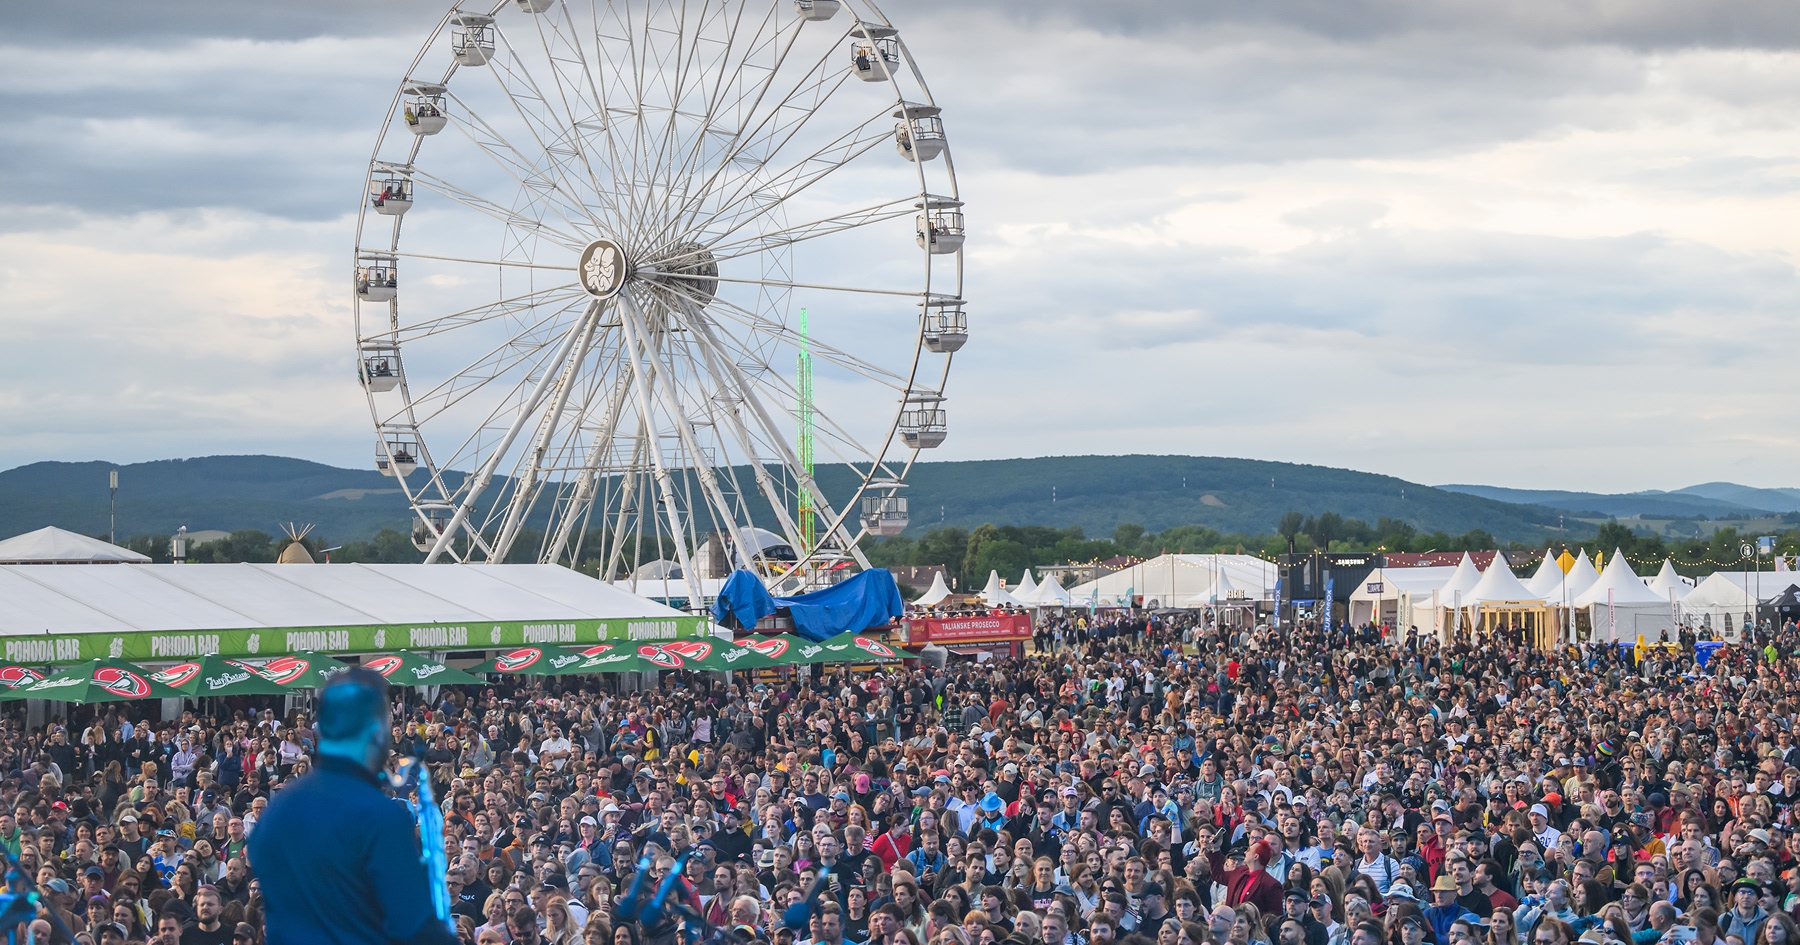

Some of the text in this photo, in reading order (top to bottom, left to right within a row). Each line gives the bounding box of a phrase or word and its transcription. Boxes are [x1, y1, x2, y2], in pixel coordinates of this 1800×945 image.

[523, 624, 577, 644] POHODA BAR
[627, 621, 677, 640] POHODA BAR
[942, 620, 1000, 631] TALIANSKE PROSECCO
[152, 635, 220, 657] POHODA BAR
[286, 630, 349, 651] POHODA BAR
[410, 626, 468, 647] POHODA BAR
[6, 639, 80, 663] POHODA BAR
